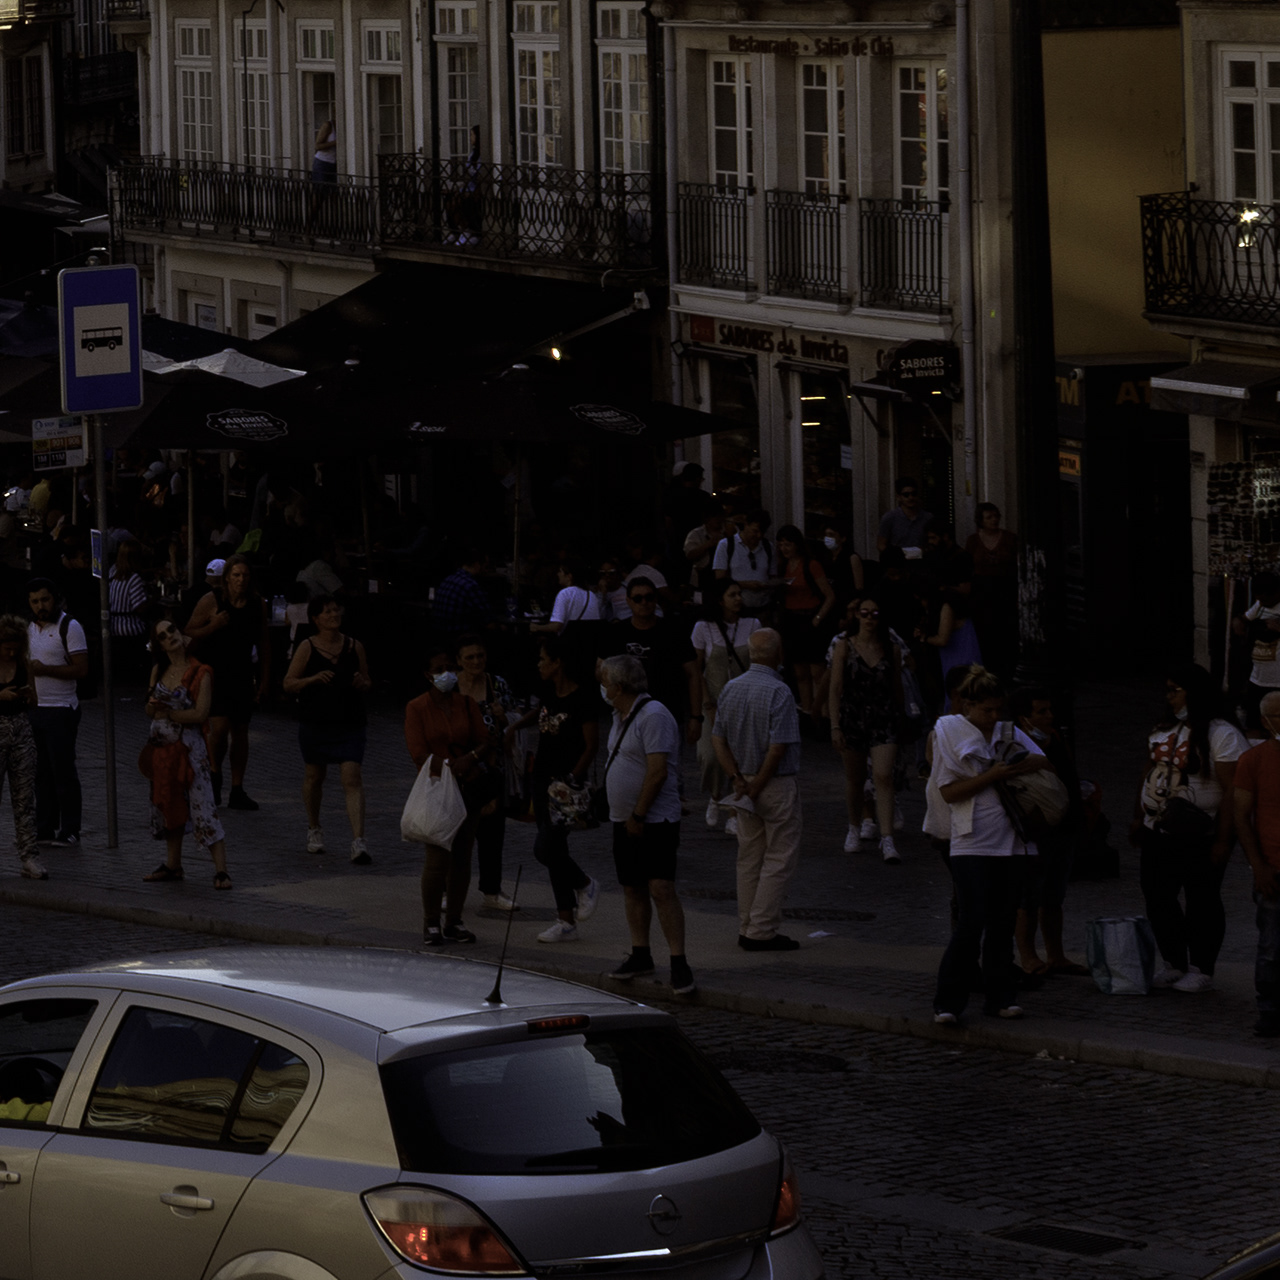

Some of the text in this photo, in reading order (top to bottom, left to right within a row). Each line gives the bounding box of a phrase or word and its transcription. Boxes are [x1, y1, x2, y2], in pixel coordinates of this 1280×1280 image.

[728, 34, 894, 56] Restaurante Salão de Chá
[718, 324, 774, 353] SABORES
[777, 328, 797, 356] da
[800, 335, 849, 363] Invicta
[900, 356, 945, 370] SABORES
[914, 368, 945, 377] Invicta
[1115, 380, 1152, 406] AT
[218, 415, 269, 424] SABORES
